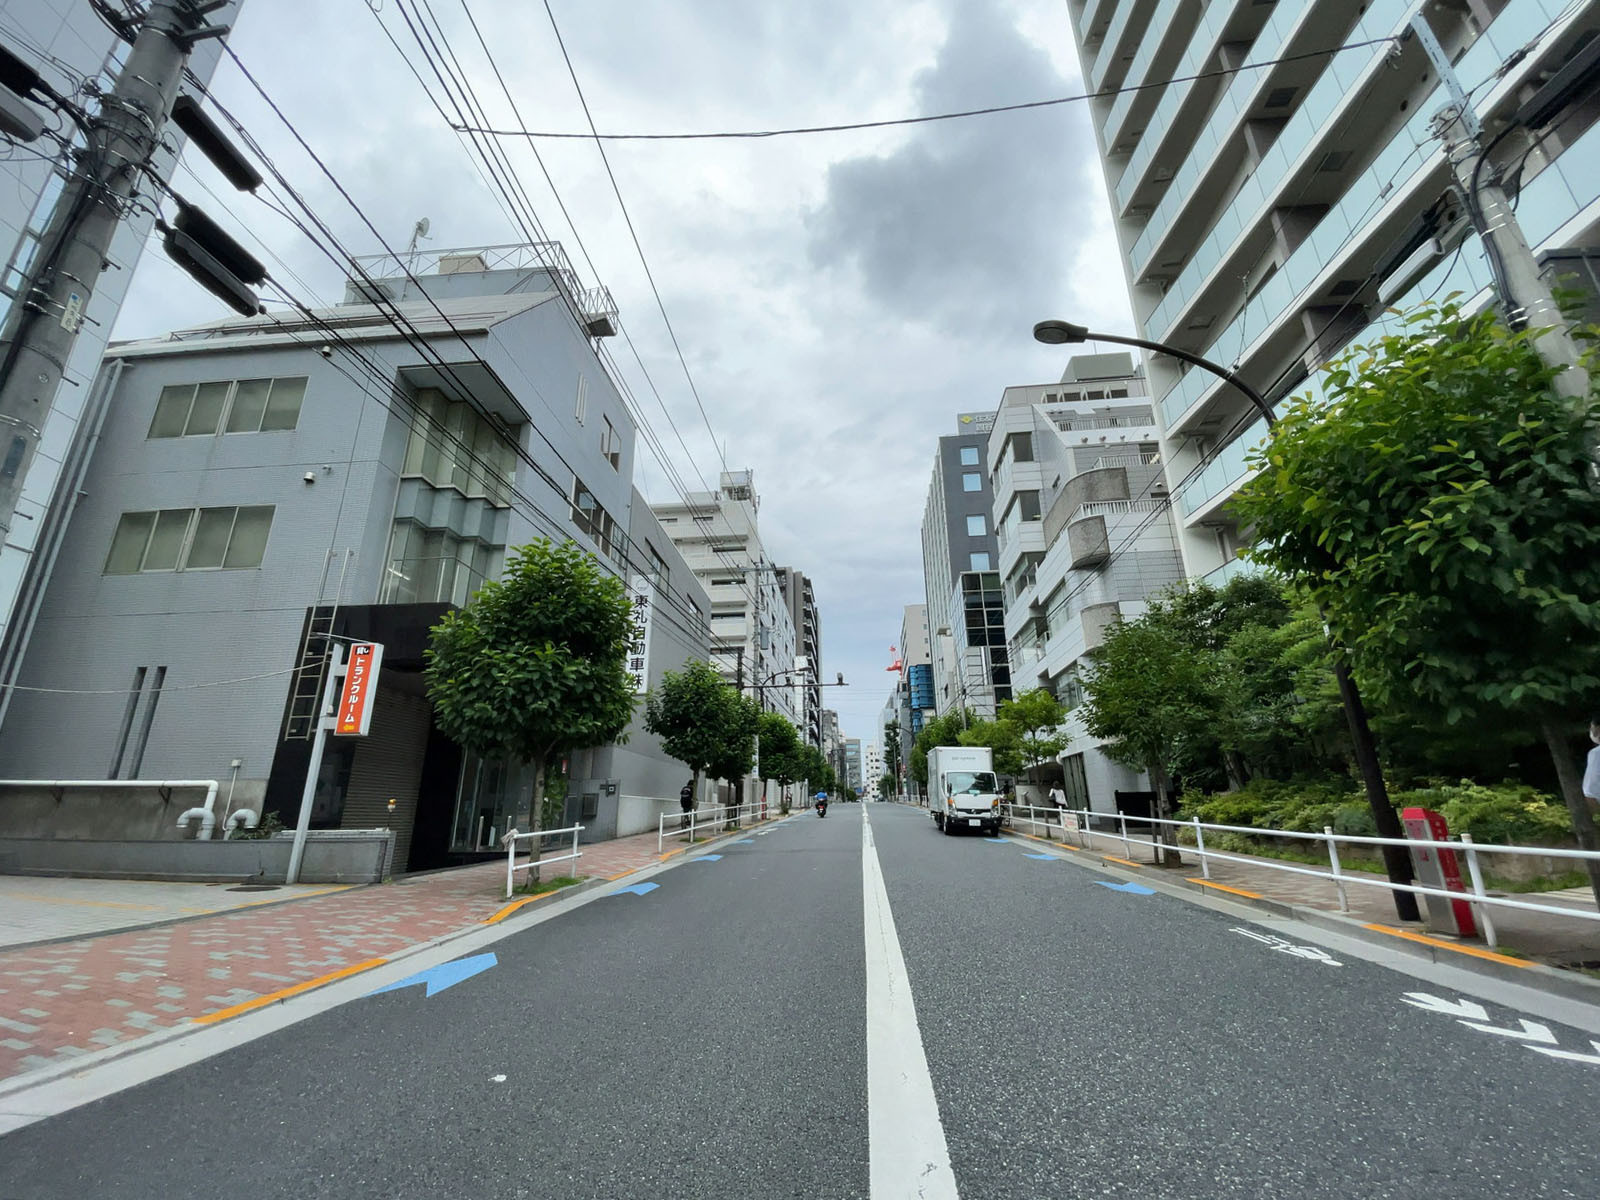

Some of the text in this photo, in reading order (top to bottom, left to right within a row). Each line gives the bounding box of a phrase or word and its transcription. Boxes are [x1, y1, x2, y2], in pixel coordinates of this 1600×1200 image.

[345, 657, 365, 722] トランクルーム
